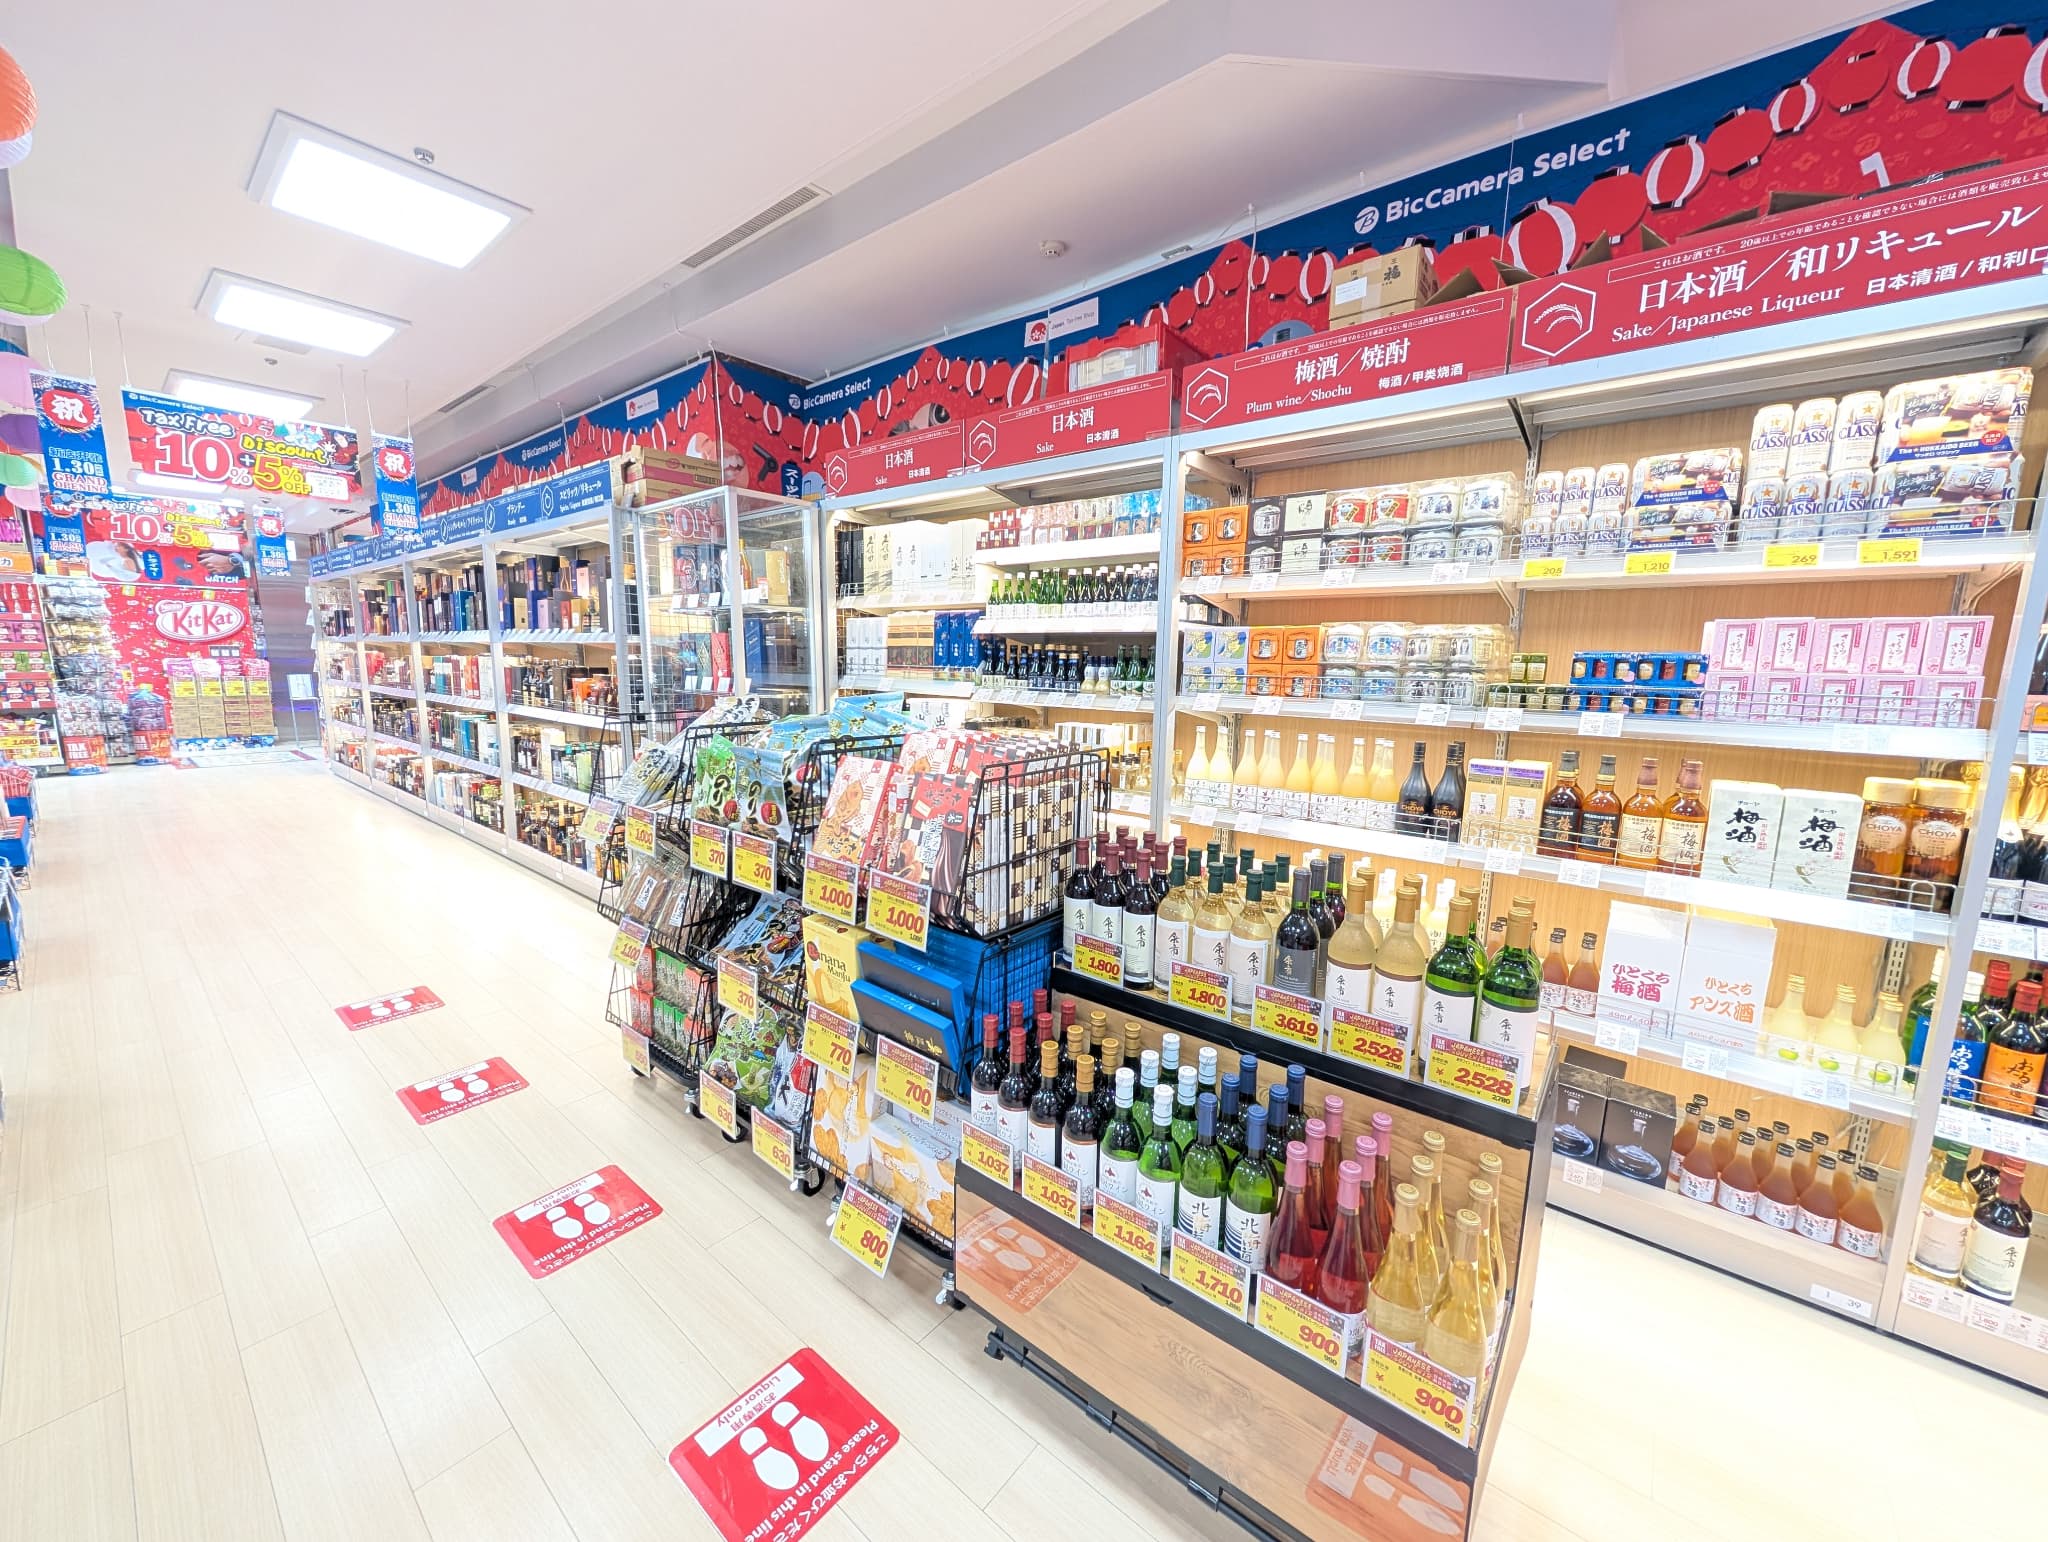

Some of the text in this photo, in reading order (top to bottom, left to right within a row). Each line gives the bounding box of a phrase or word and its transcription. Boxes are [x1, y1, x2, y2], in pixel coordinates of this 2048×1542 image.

[1385, 127, 1631, 223] BicCamera Select
[1761, 286, 1844, 314] Liqueur
[803, 376, 872, 411] BicCamera Select
[51, 394, 88, 424] 祝
[1051, 407, 1094, 434] 日本酒
[1246, 400, 1272, 415] Plum
[141, 408, 234, 437] Tax Free
[241, 434, 328, 464] Discount
[885, 448, 914, 469] 日本酒
[1036, 442, 1054, 454] Sake
[385, 452, 407, 474] 祝
[52, 472, 107, 486] GRAND
[54, 480, 109, 494] OPENING
[282, 481, 312, 495] OFF
[875, 475, 888, 487] Sake
[1791, 554, 1818, 565] 269
[1882, 550, 1918, 562] 1,591
[204, 575, 240, 584] WATCH
[1543, 566, 1563, 576] 205
[172, 604, 234, 636] KitKat
[1401, 803, 1425, 813] CHOYA
[1432, 807, 1458, 818] CHOYA
[635, 828, 654, 846] 1,000
[1726, 807, 1767, 844] 梅酒
[1798, 815, 1845, 853] 梅酒
[1865, 823, 1904, 834] CHOYA
[1918, 828, 1958, 840] CHOYA
[708, 848, 726, 866] 370
[753, 863, 772, 882] 370
[820, 884, 854, 910] 1,000
[885, 906, 925, 935] 1,000
[620, 942, 641, 962] 1,100
[826, 965, 852, 983] Manju
[1088, 955, 1121, 978] 1,800
[1612, 963, 1671, 984] ひとくち
[737, 990, 755, 1008] 370
[1187, 986, 1226, 1009] 1,800
[1611, 975, 1661, 1003] 梅酒
[1704, 976, 1753, 996] ひとくち
[1689, 996, 1756, 1024] アンズ酒
[1274, 1012, 1319, 1038] 3,619
[1500, 1017, 1514, 1043] 余市
[830, 1041, 852, 1067] 770
[1353, 1036, 1403, 1064] 2,528
[905, 1080, 932, 1107] 700
[1453, 1067, 1514, 1097] 2,528
[717, 1106, 734, 1124] 630
[772, 1145, 791, 1165] 630
[978, 1150, 1011, 1175] 1,037
[533, 1179, 587, 1208] Liquor only
[1040, 1185, 1078, 1214] 1,037
[532, 1202, 650, 1267] Please stand in this line
[860, 1229, 889, 1259] 800
[1113, 1223, 1157, 1257] 1,164
[1195, 1269, 1244, 1305] 1,710
[1298, 1324, 1340, 1357] 900
[1392, 1345, 1432, 1372] JAPANESE
[716, 1375, 783, 1429] Liquor only
[731, 1391, 778, 1432] お酒専用
[1414, 1388, 1464, 1425] 900
[744, 1418, 880, 1542] Please stand in this line
